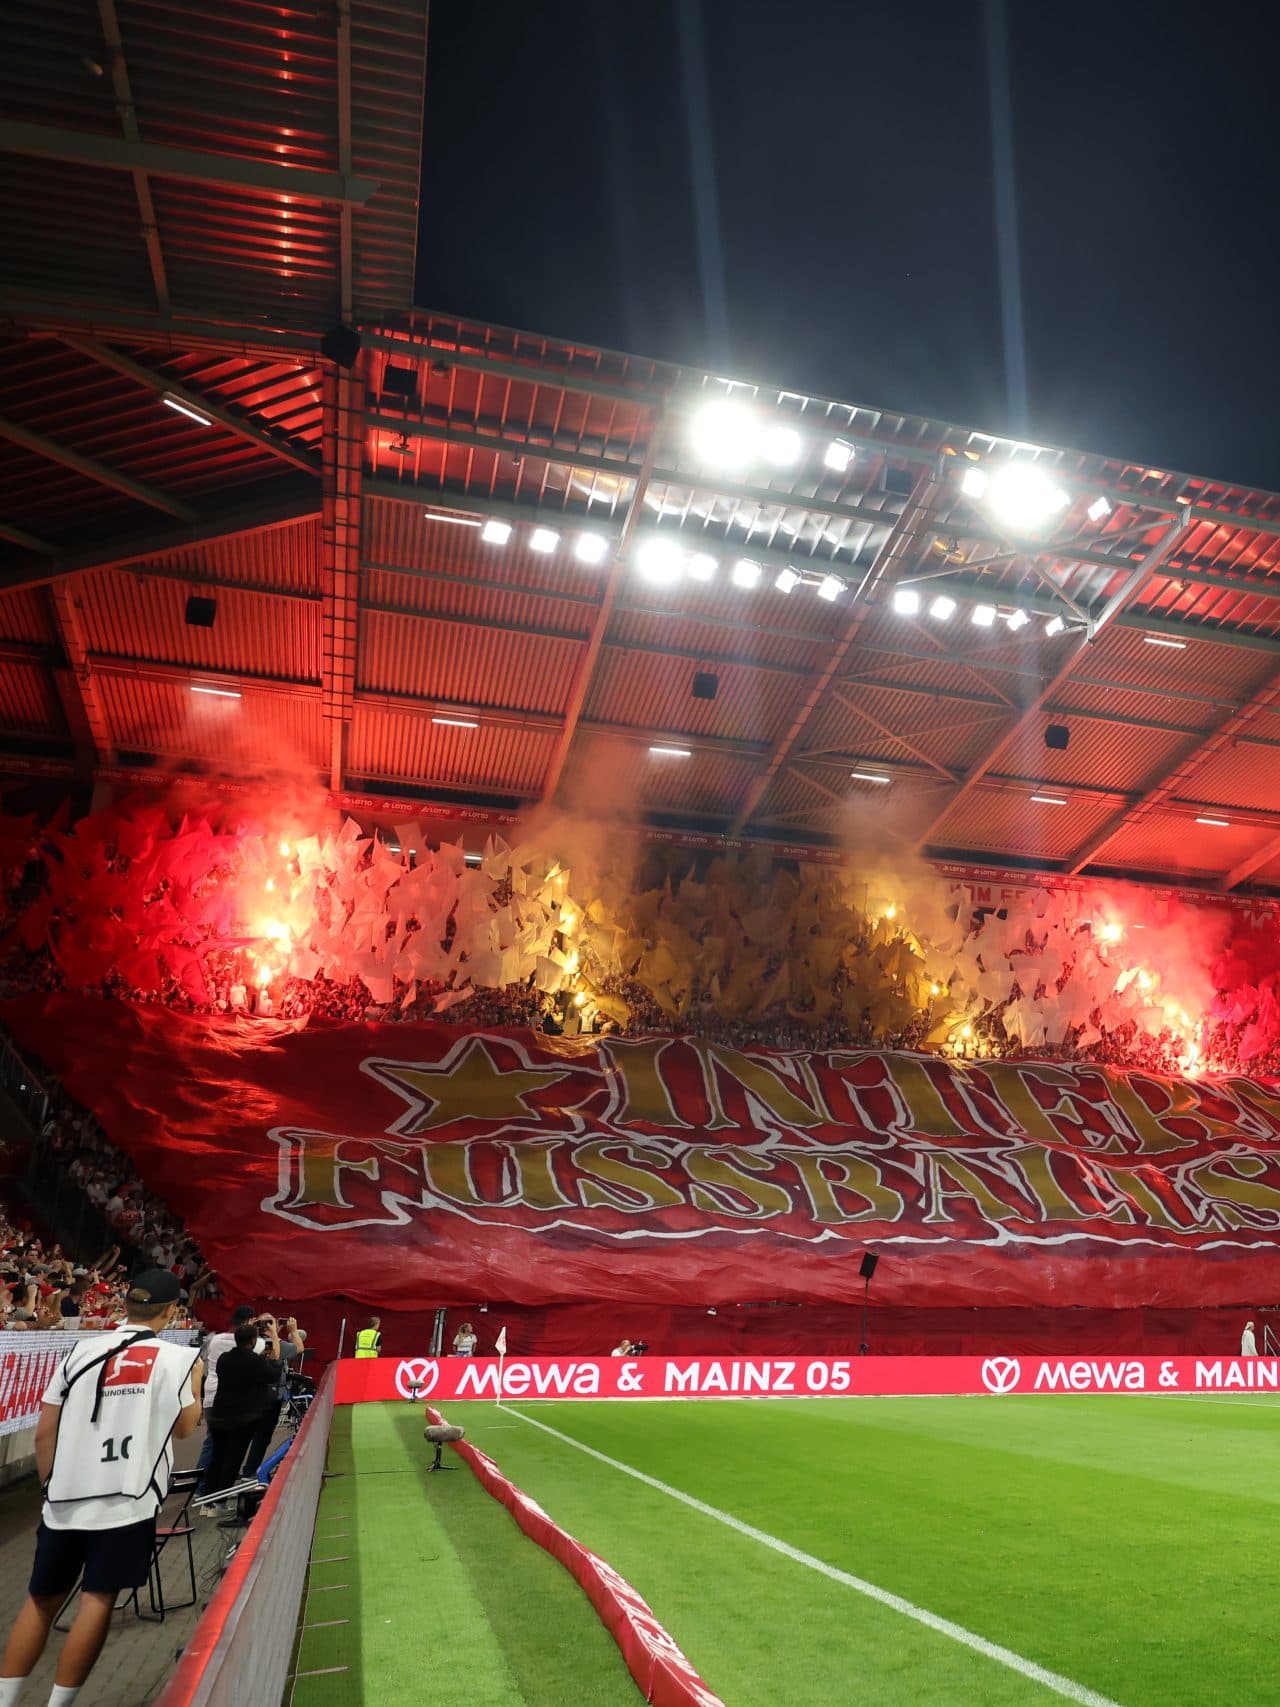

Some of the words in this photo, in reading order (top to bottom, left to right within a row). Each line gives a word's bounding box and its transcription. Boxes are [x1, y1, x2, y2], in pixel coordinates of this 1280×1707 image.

[617, 1362, 644, 1391] &
[664, 1361, 796, 1391] MAINZ
[806, 1361, 852, 1391] 05
[1158, 1361, 1178, 1387] &
